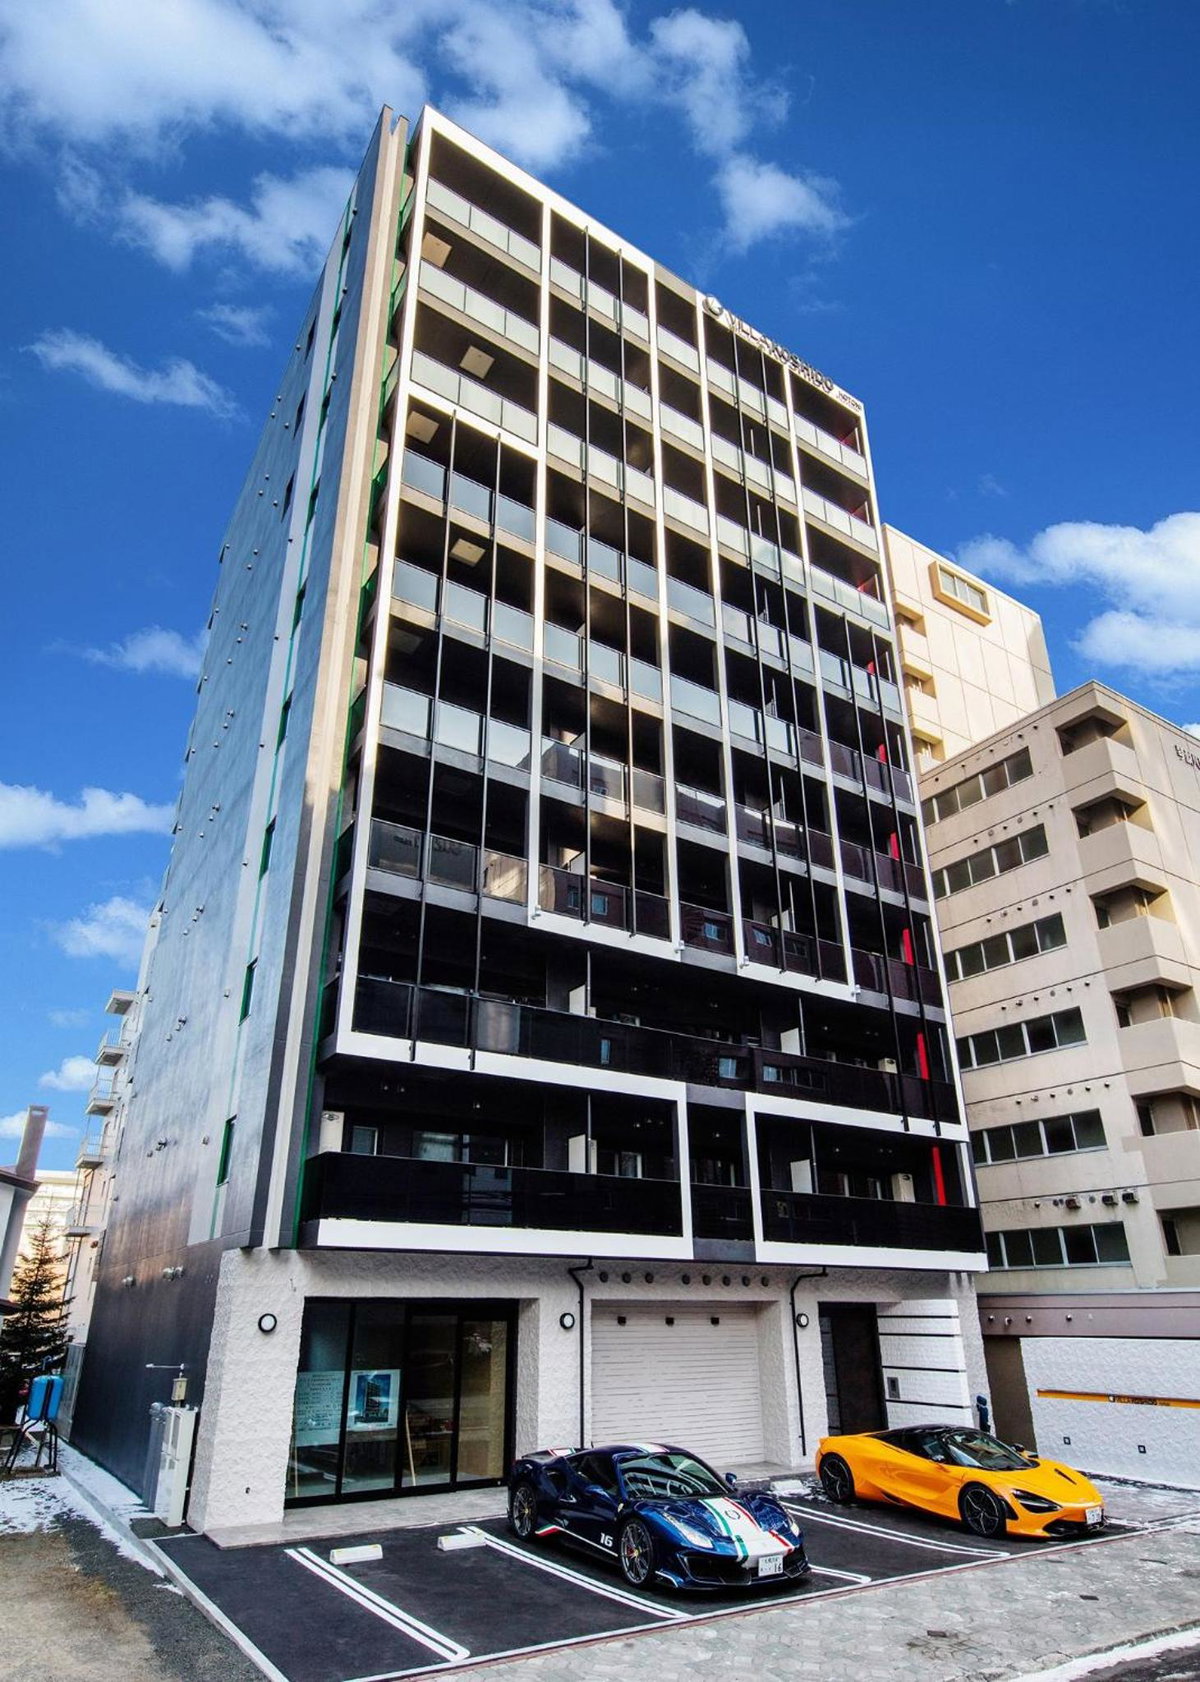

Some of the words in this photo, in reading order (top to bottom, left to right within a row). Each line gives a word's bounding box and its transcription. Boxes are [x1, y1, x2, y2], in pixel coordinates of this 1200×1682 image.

[725, 309, 770, 350] VILLA
[768, 340, 834, 393] KOSHIDO
[600, 1532, 613, 1547] 16
